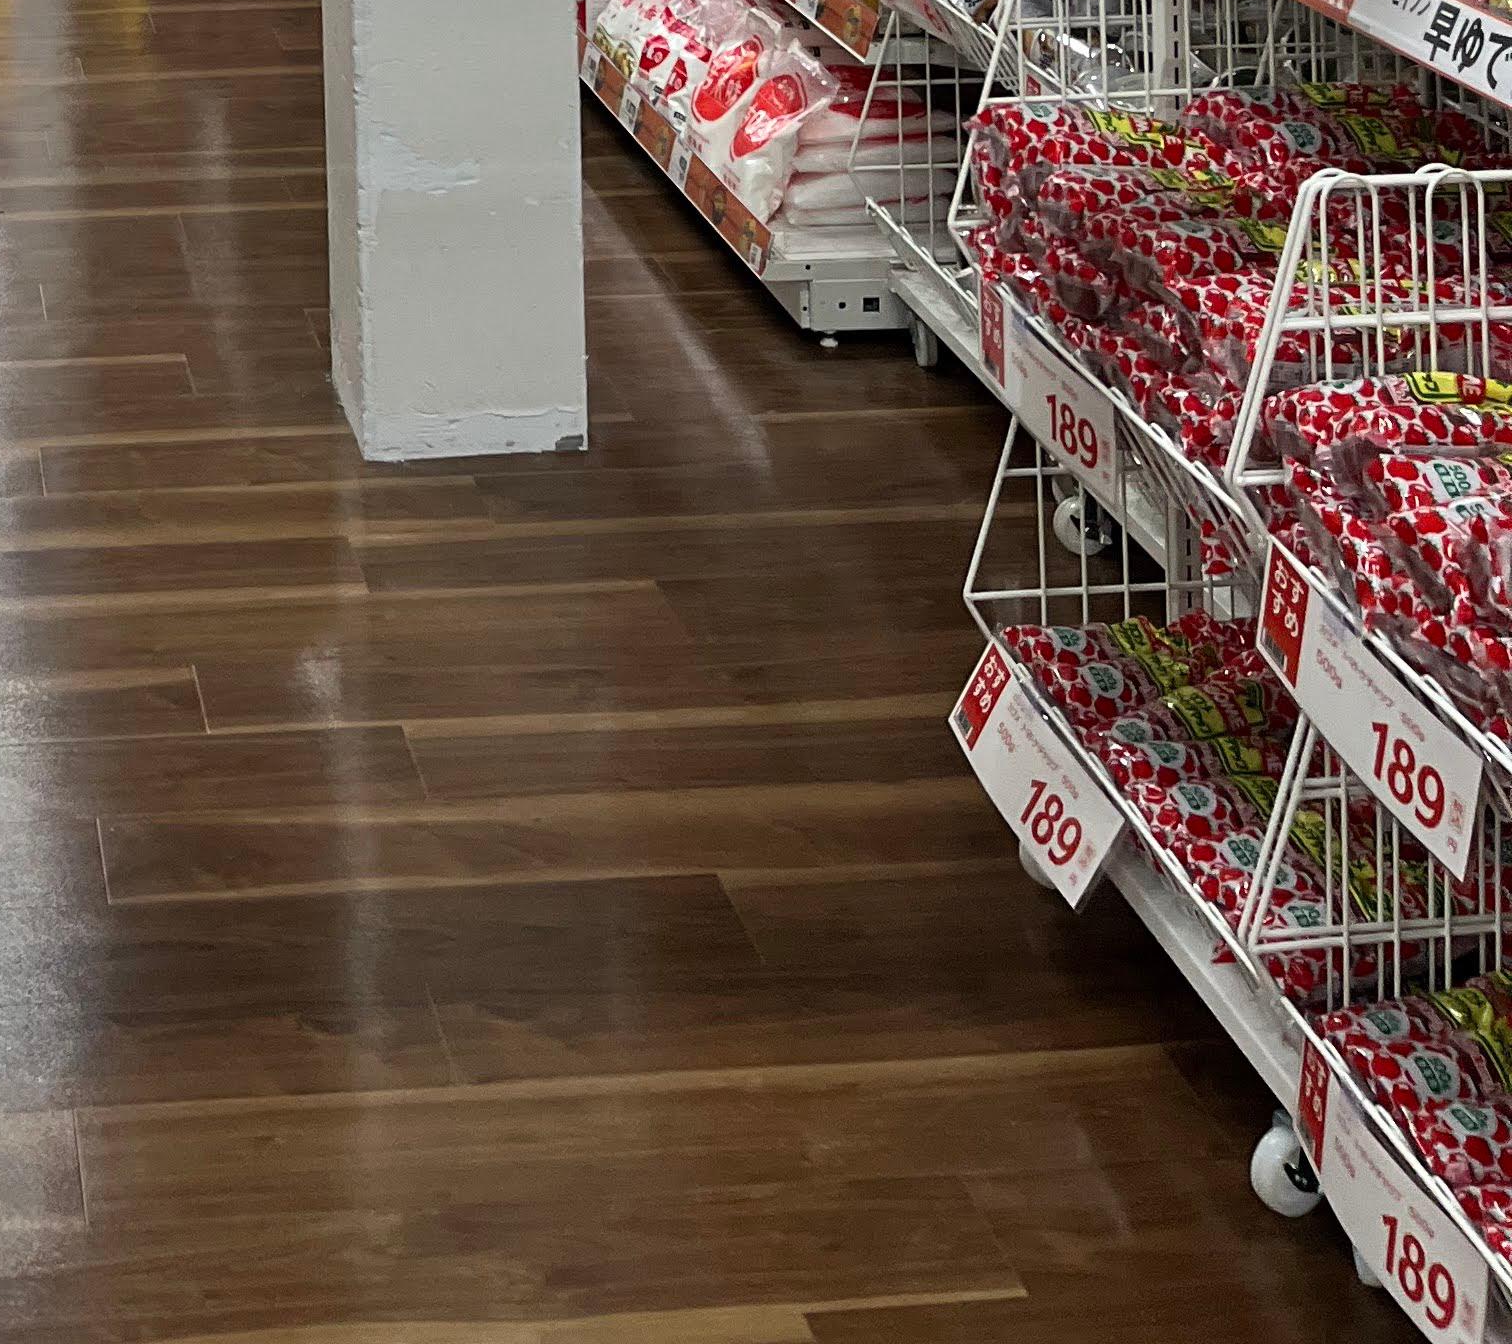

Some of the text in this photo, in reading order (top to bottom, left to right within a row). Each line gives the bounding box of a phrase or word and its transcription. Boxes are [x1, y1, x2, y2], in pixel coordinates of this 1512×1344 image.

[1045, 394, 1098, 469] 189
[1020, 779, 1082, 866] 189
[1371, 721, 1445, 829] 189
[1382, 1214, 1456, 1330] 189
